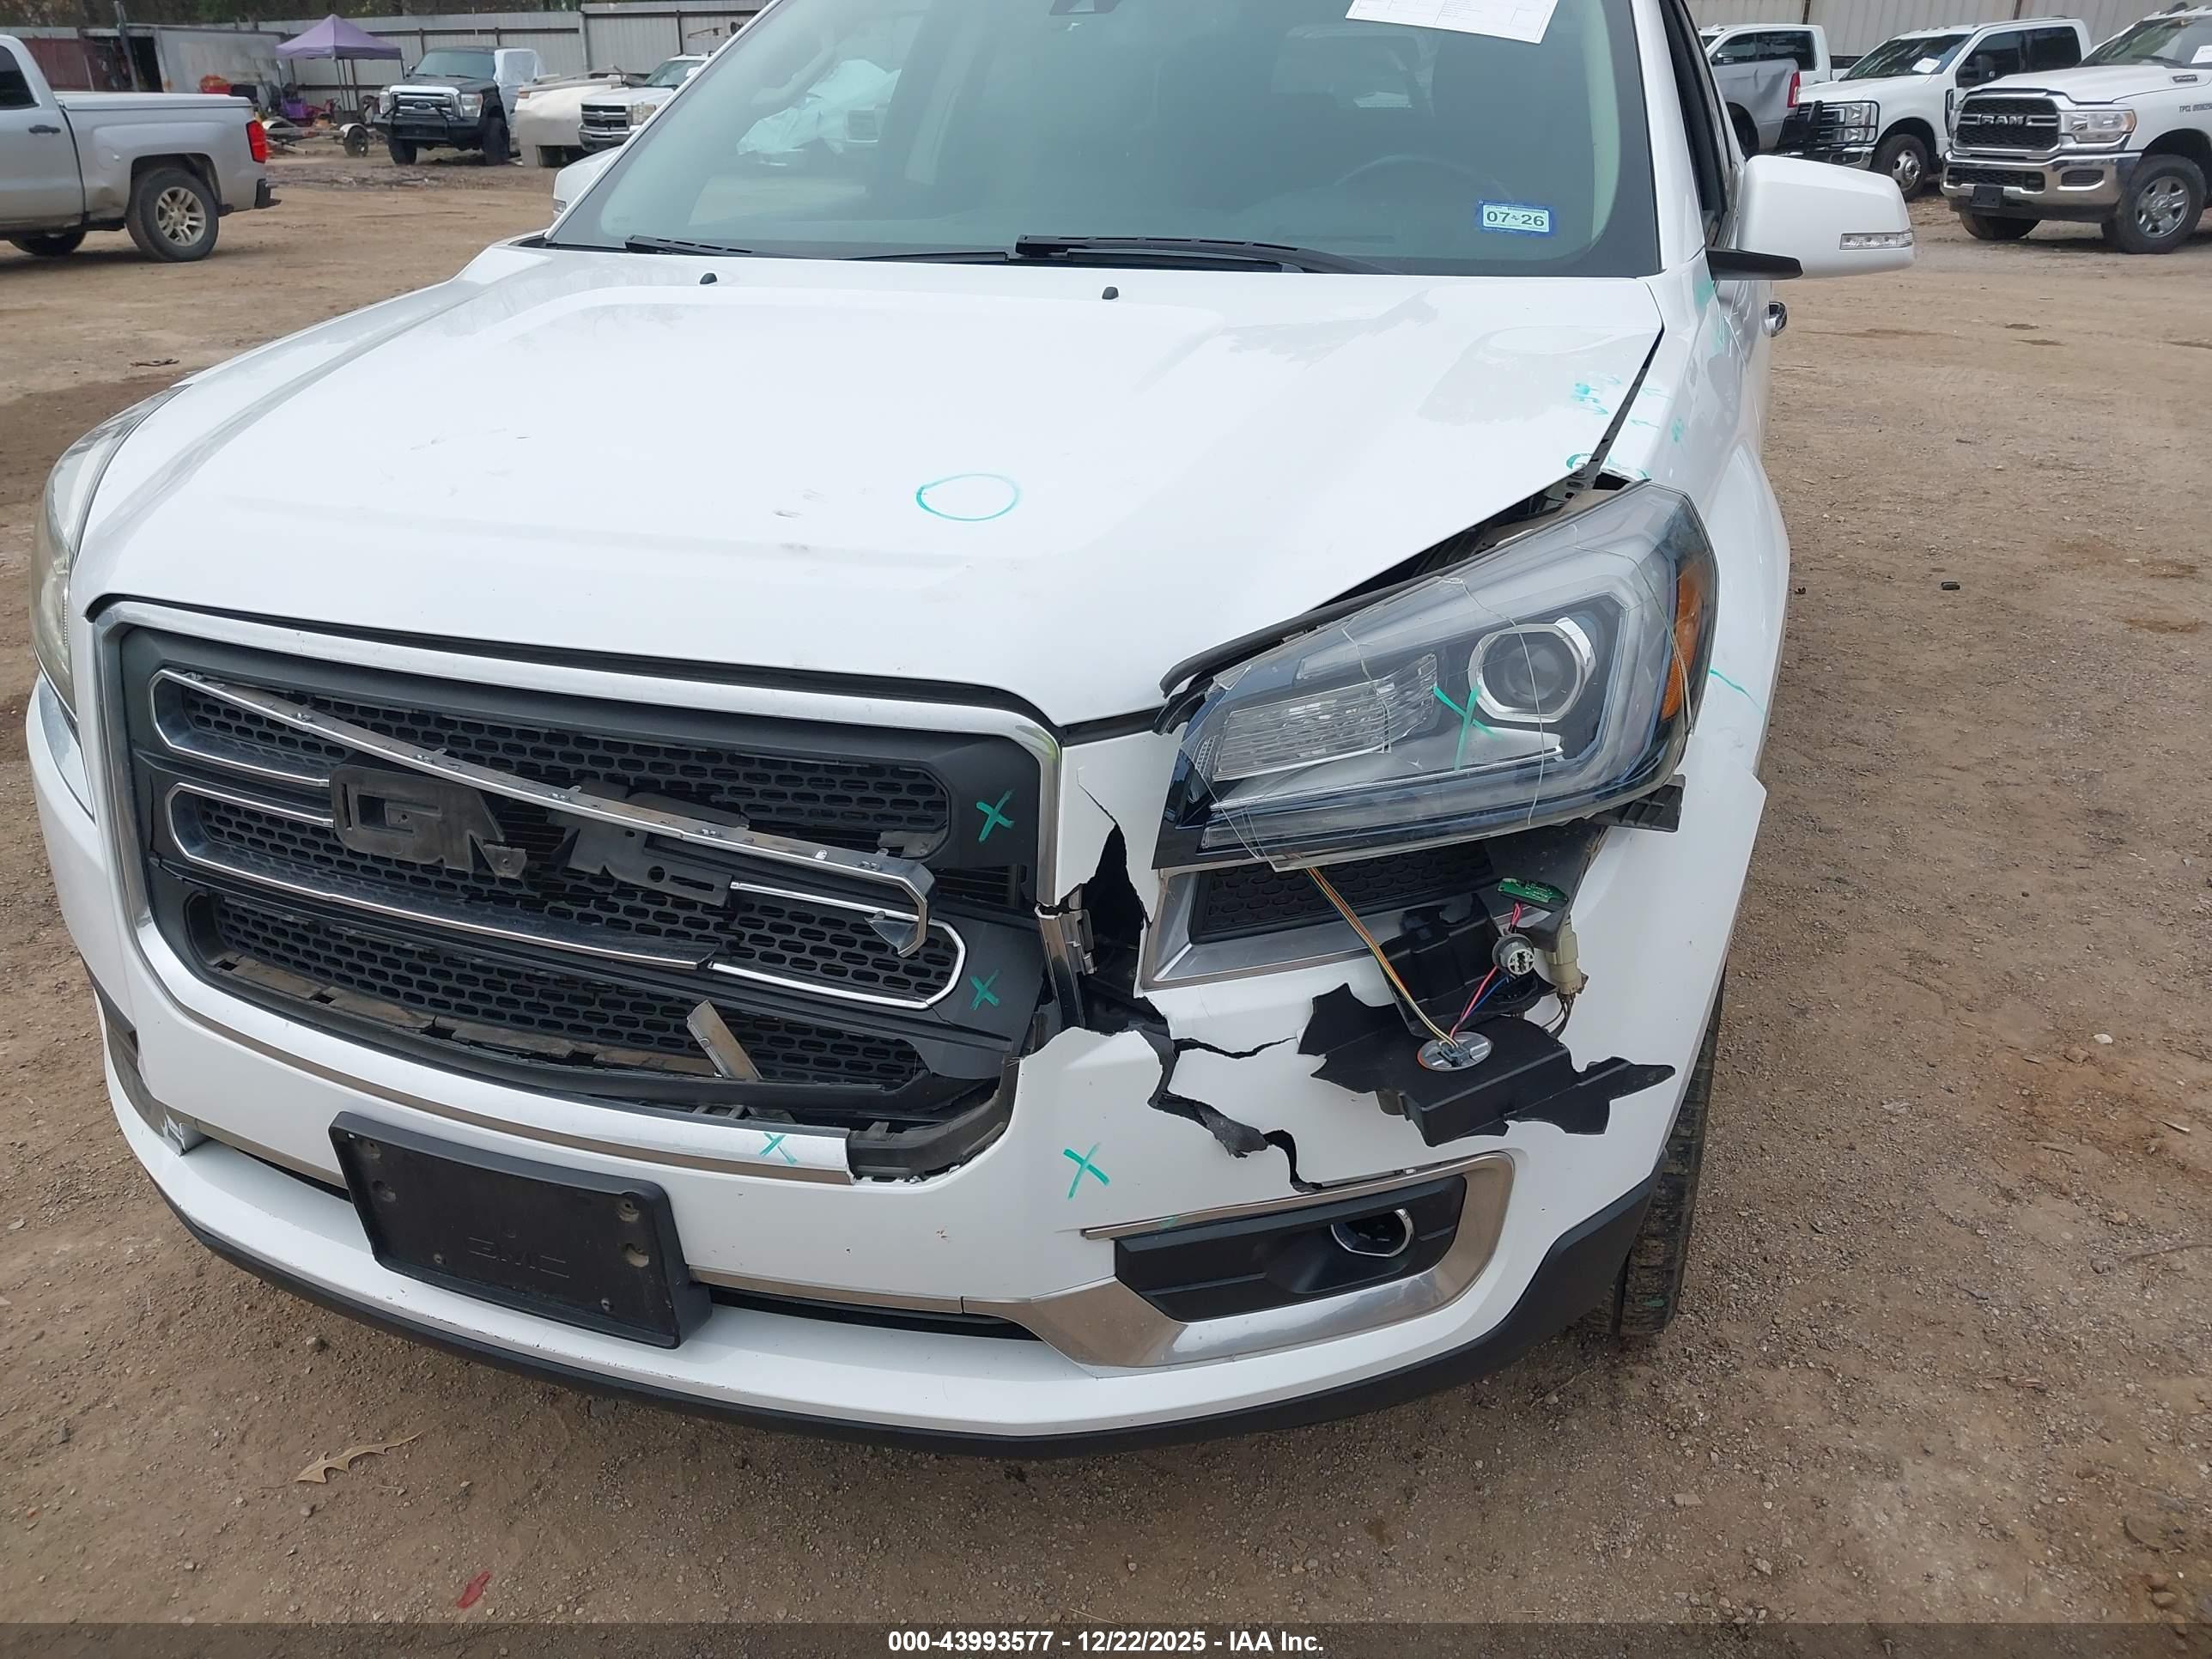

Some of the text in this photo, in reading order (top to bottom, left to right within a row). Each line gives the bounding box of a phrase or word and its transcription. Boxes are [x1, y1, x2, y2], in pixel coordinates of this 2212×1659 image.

[1981, 114, 2025, 125] RAM
[1486, 211, 1545, 227] 07 26
